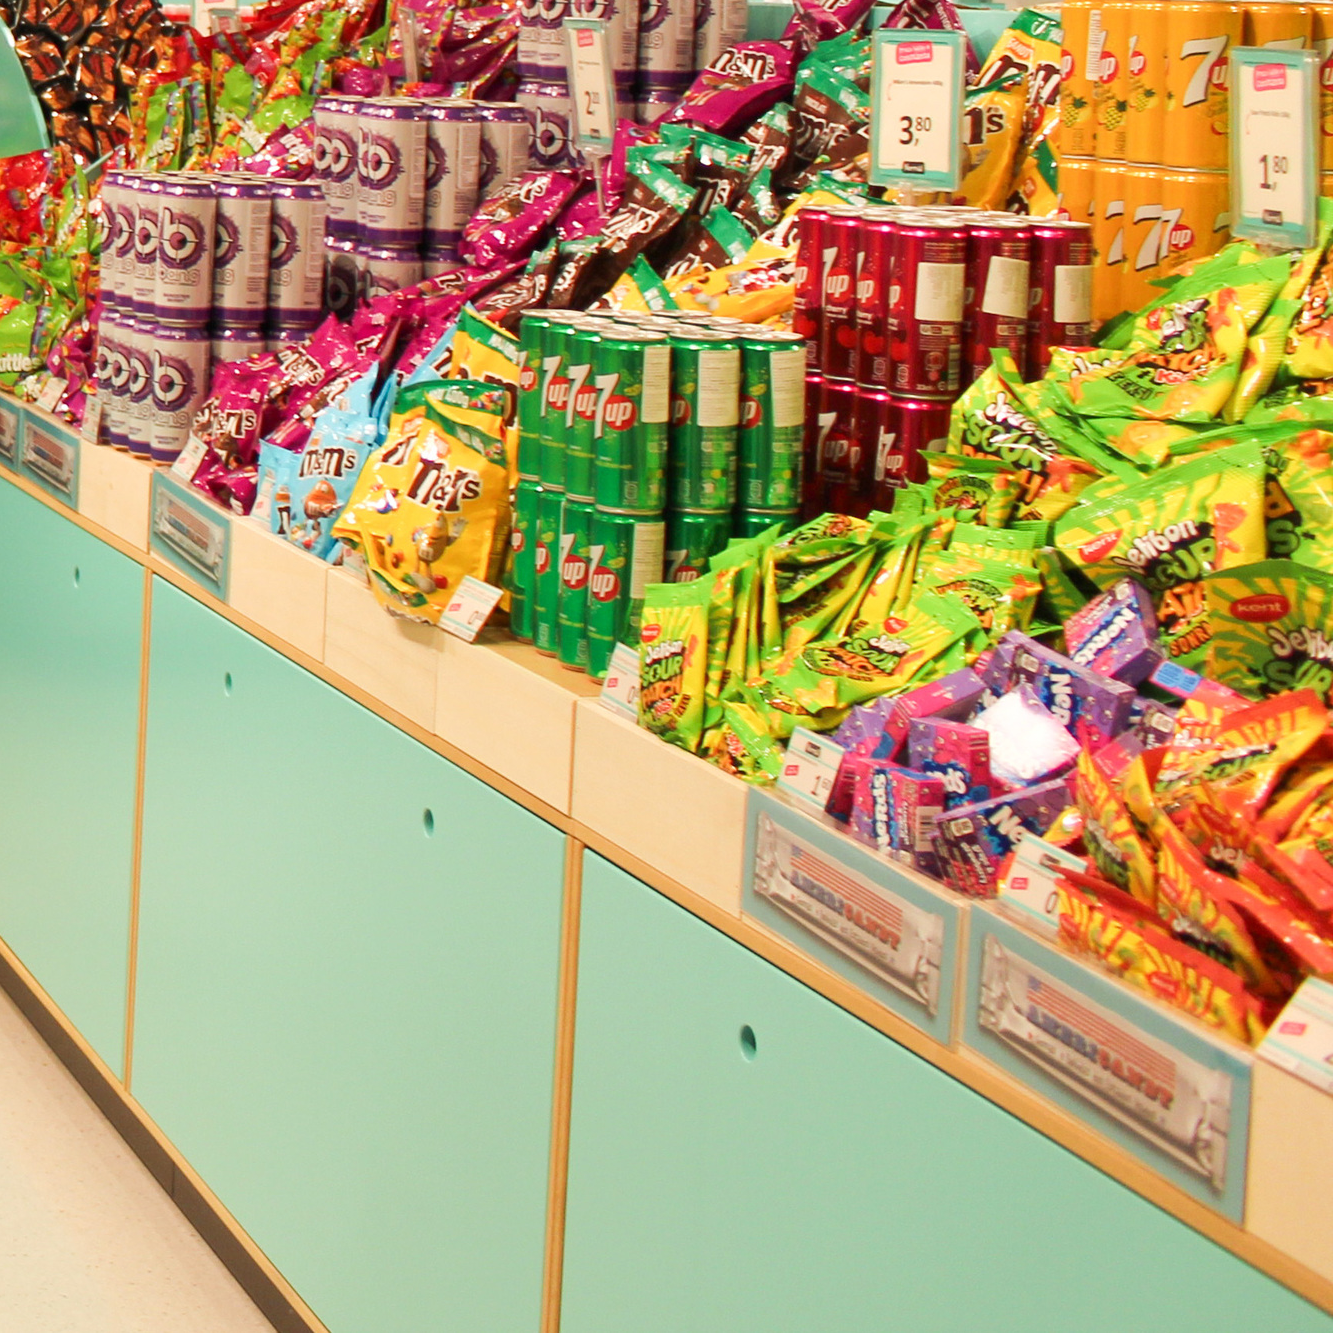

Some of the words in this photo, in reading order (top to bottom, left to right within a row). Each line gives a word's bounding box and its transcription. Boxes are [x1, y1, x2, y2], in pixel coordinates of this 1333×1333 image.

[899, 115, 932, 147] 3,80
[1259, 155, 1288, 191] 1,80
[1236, 602, 1282, 614] kent
[1073, 606, 1137, 666] Nerds
